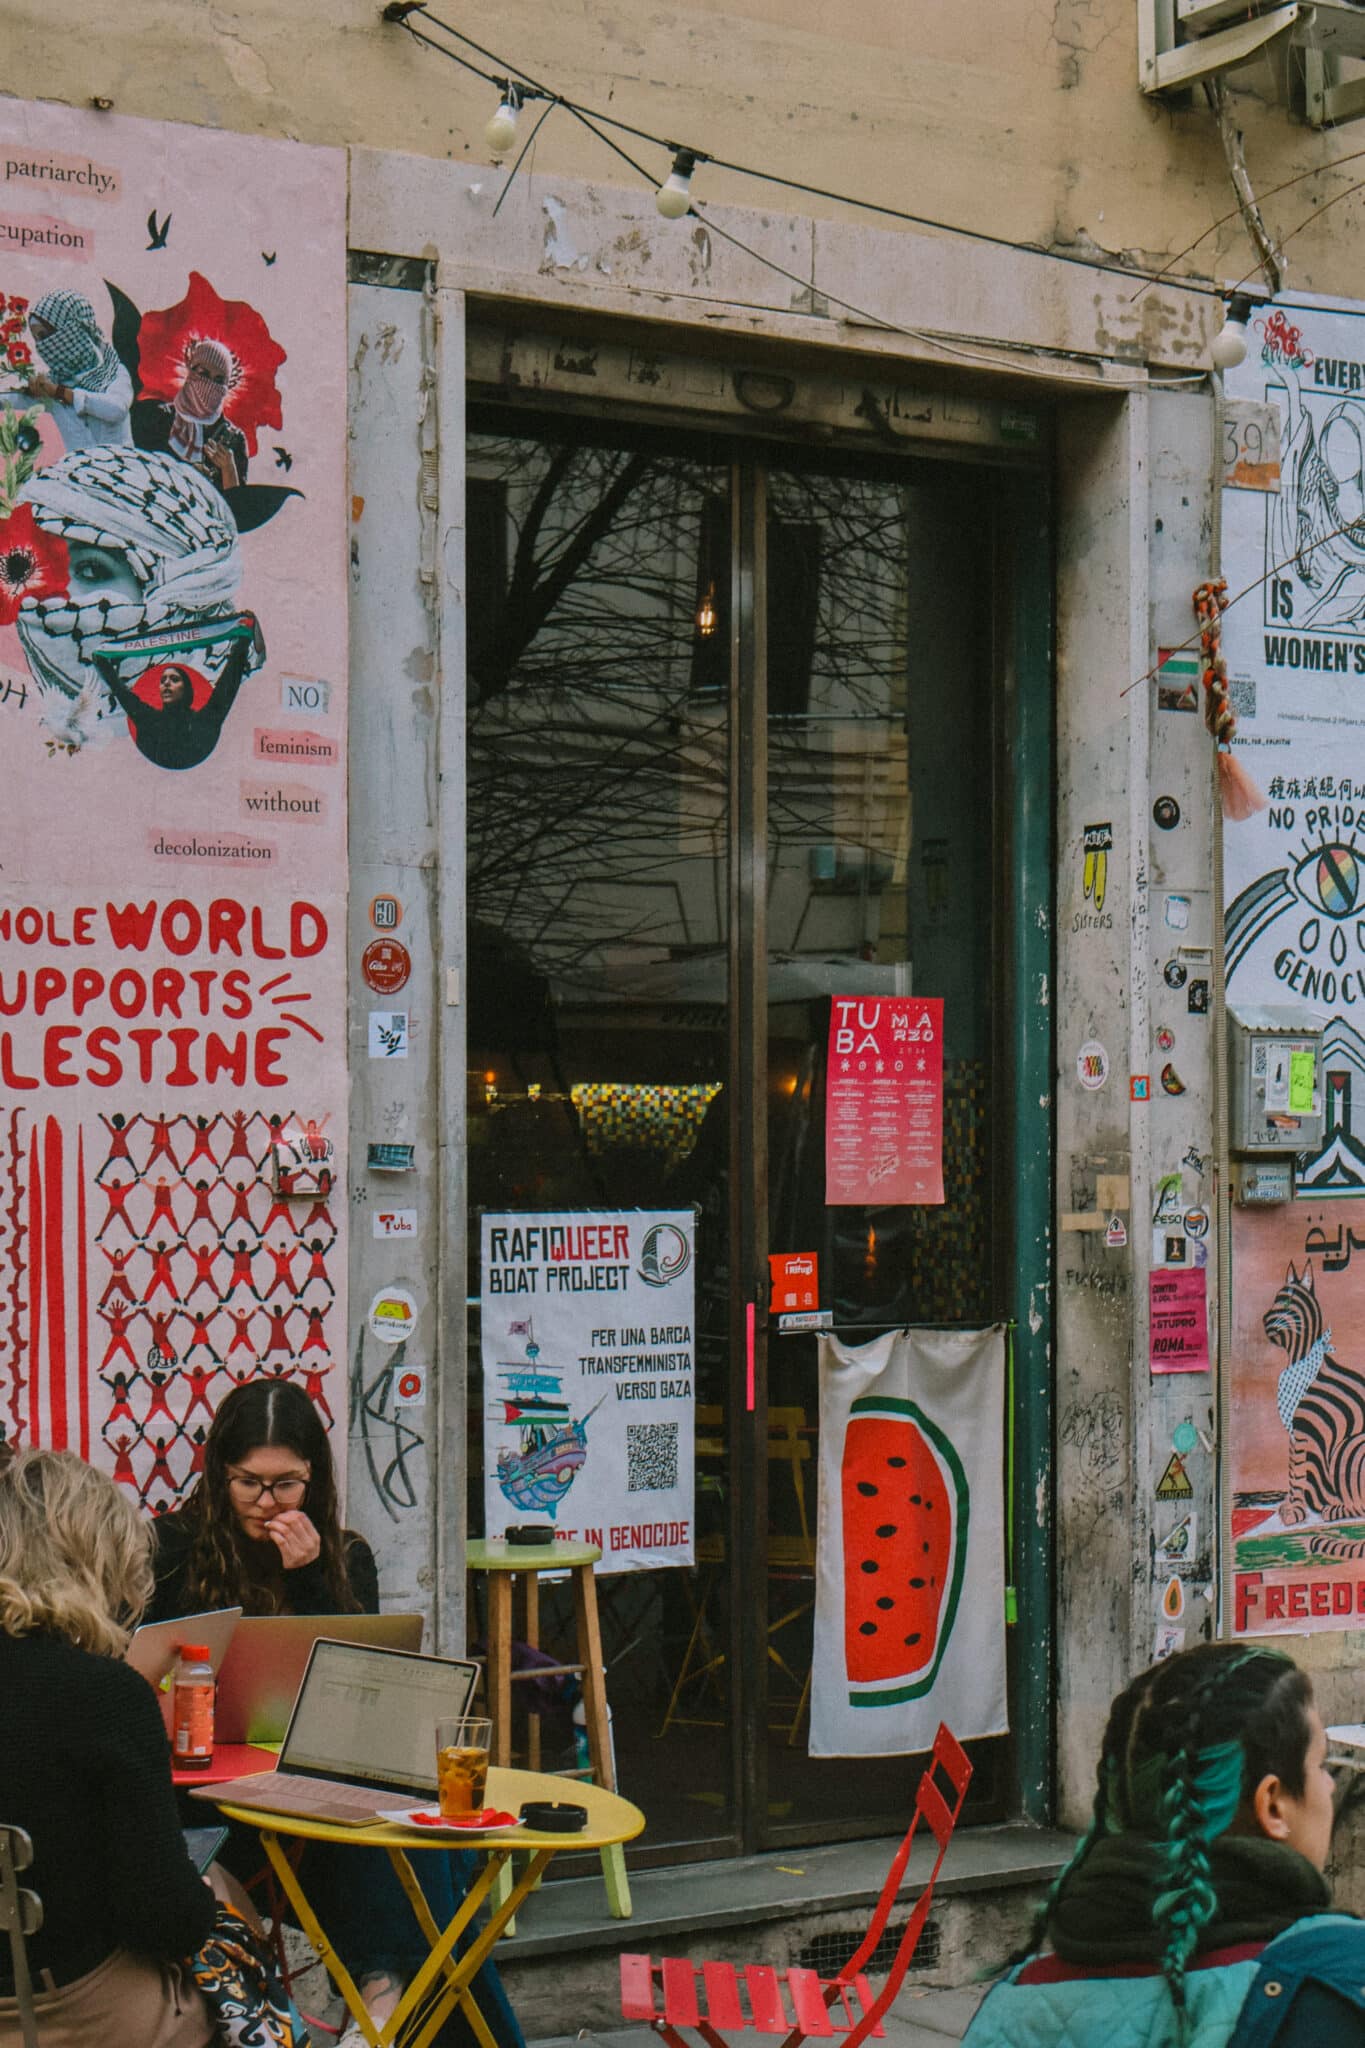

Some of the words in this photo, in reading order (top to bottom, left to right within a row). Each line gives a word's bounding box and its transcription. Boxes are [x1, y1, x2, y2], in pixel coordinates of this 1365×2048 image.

[6, 159, 117, 194] patriarchy,
[1271, 579, 1293, 620] IS
[124, 629, 202, 650] PALESTINE
[287, 685, 320, 709] NO
[259, 736, 332, 757] feminism
[245, 791, 321, 814] without
[1268, 806, 1295, 831] NO
[153, 837, 272, 860] decolonization
[106, 898, 329, 960] WORLD
[0, 967, 252, 1020] UPPORTS
[1, 1025, 291, 1090] LESTINE
[490, 1225, 630, 1263] RAFIQUEER
[489, 1267, 539, 1294] BOAT
[546, 1265, 630, 1293] PROJECT
[591, 1329, 616, 1348] PER
[620, 1327, 646, 1347] UNA
[650, 1326, 691, 1345] BARCA
[1153, 1338, 1185, 1353] ROMA
[578, 1353, 692, 1376] TRANSFEMMINISTA
[615, 1381, 656, 1401] VERSO
[660, 1380, 692, 1399] GAZA
[609, 1521, 690, 1551] GENOCIDE
